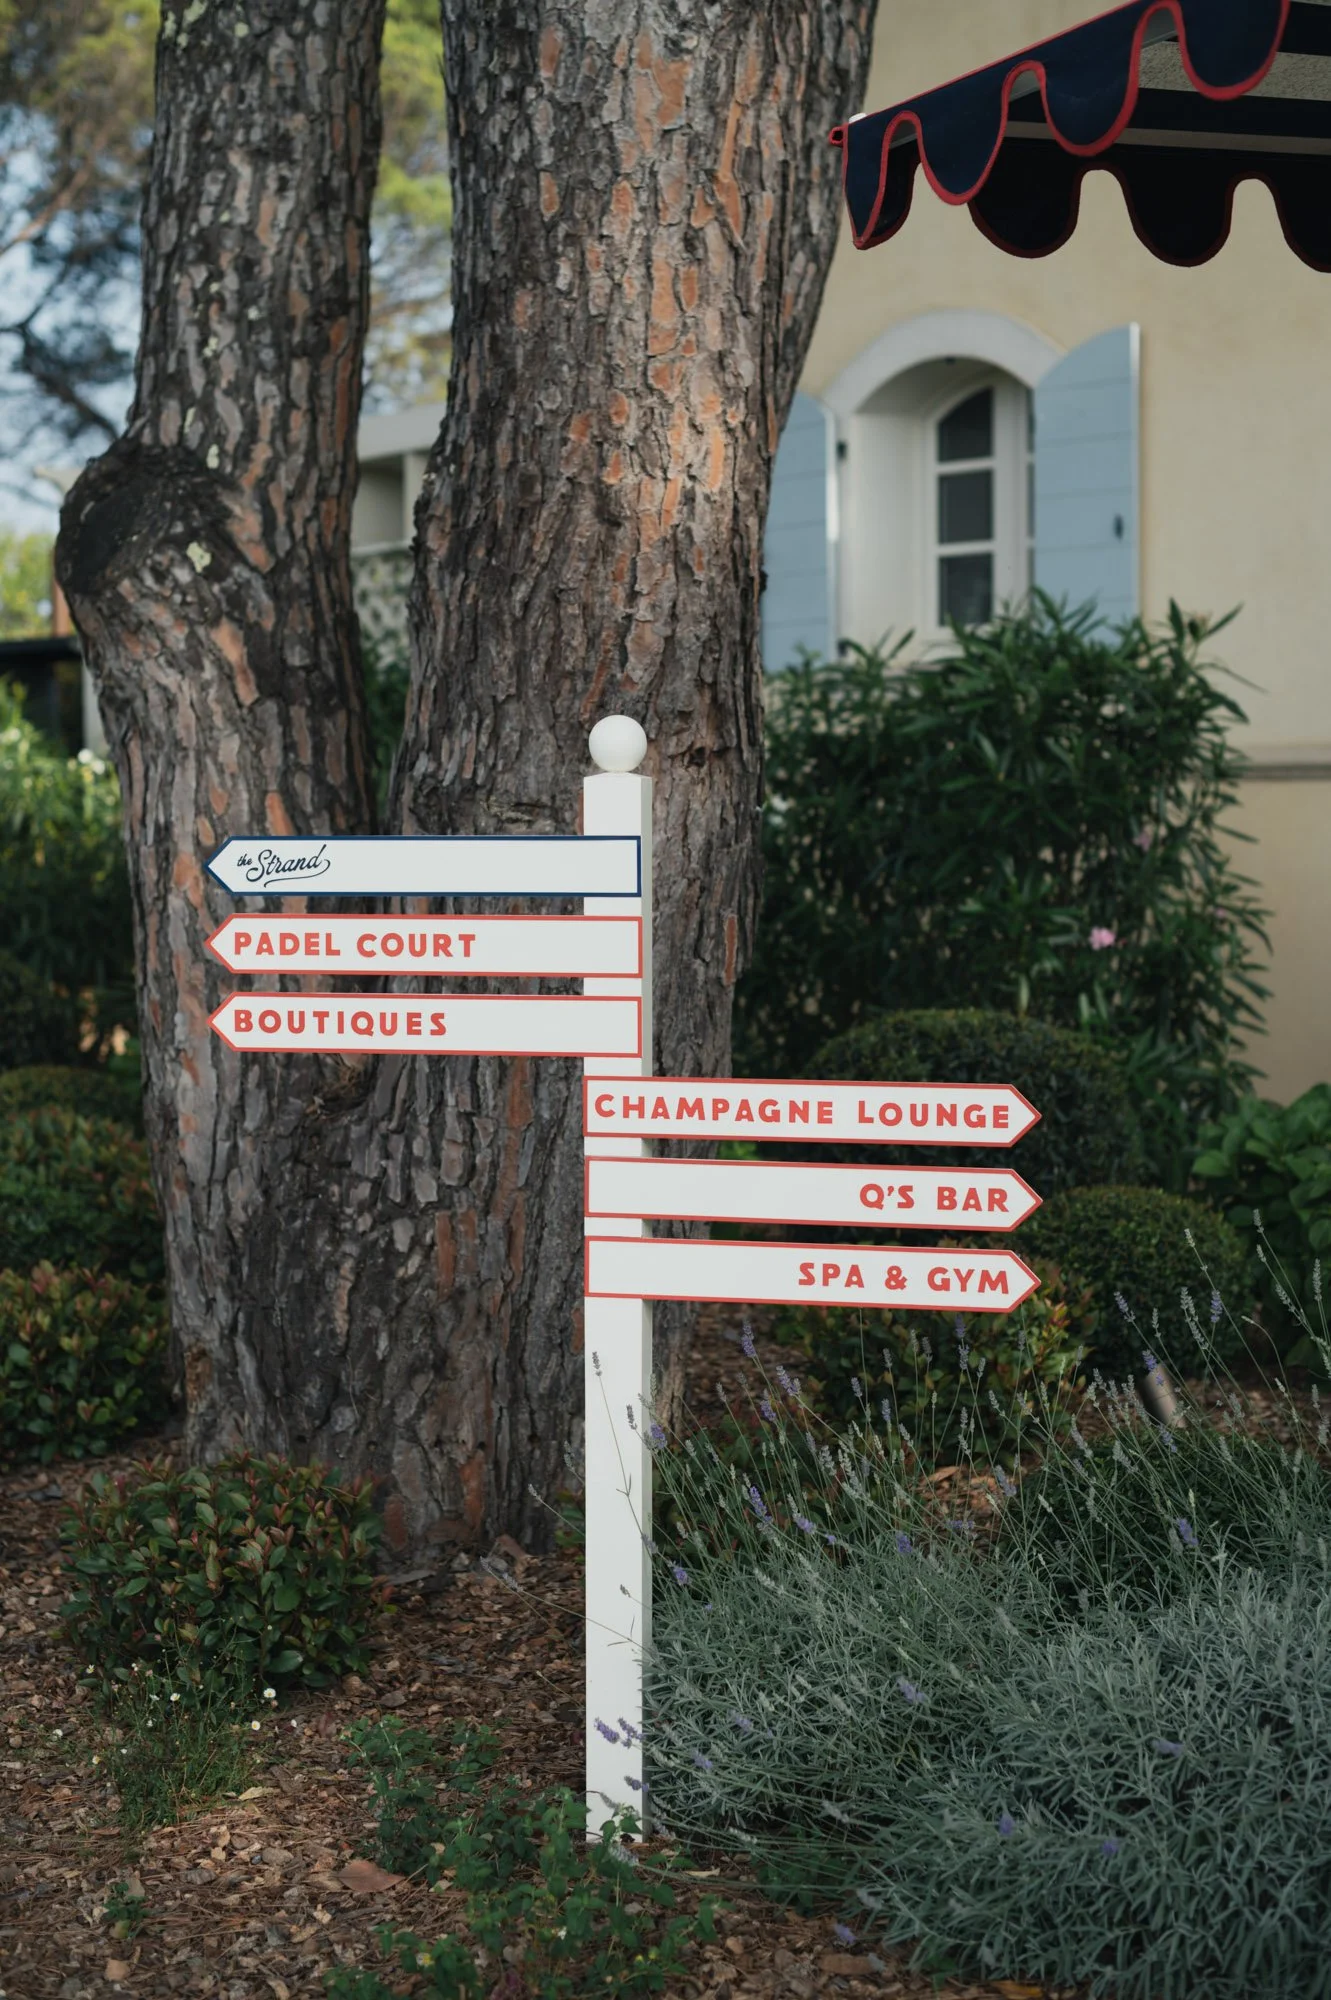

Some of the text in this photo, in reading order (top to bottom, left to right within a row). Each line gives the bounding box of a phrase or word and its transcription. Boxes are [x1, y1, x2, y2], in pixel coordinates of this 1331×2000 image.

[237, 844, 331, 888] the Strand
[233, 931, 476, 959] PADEL COURT
[233, 1009, 447, 1037] BOUTIQUES
[594, 1093, 1009, 1129] CHAMPAGNE LOUNGE
[859, 1183, 1009, 1213] Q'S BAR
[798, 1261, 1009, 1295] SPA & GYM
